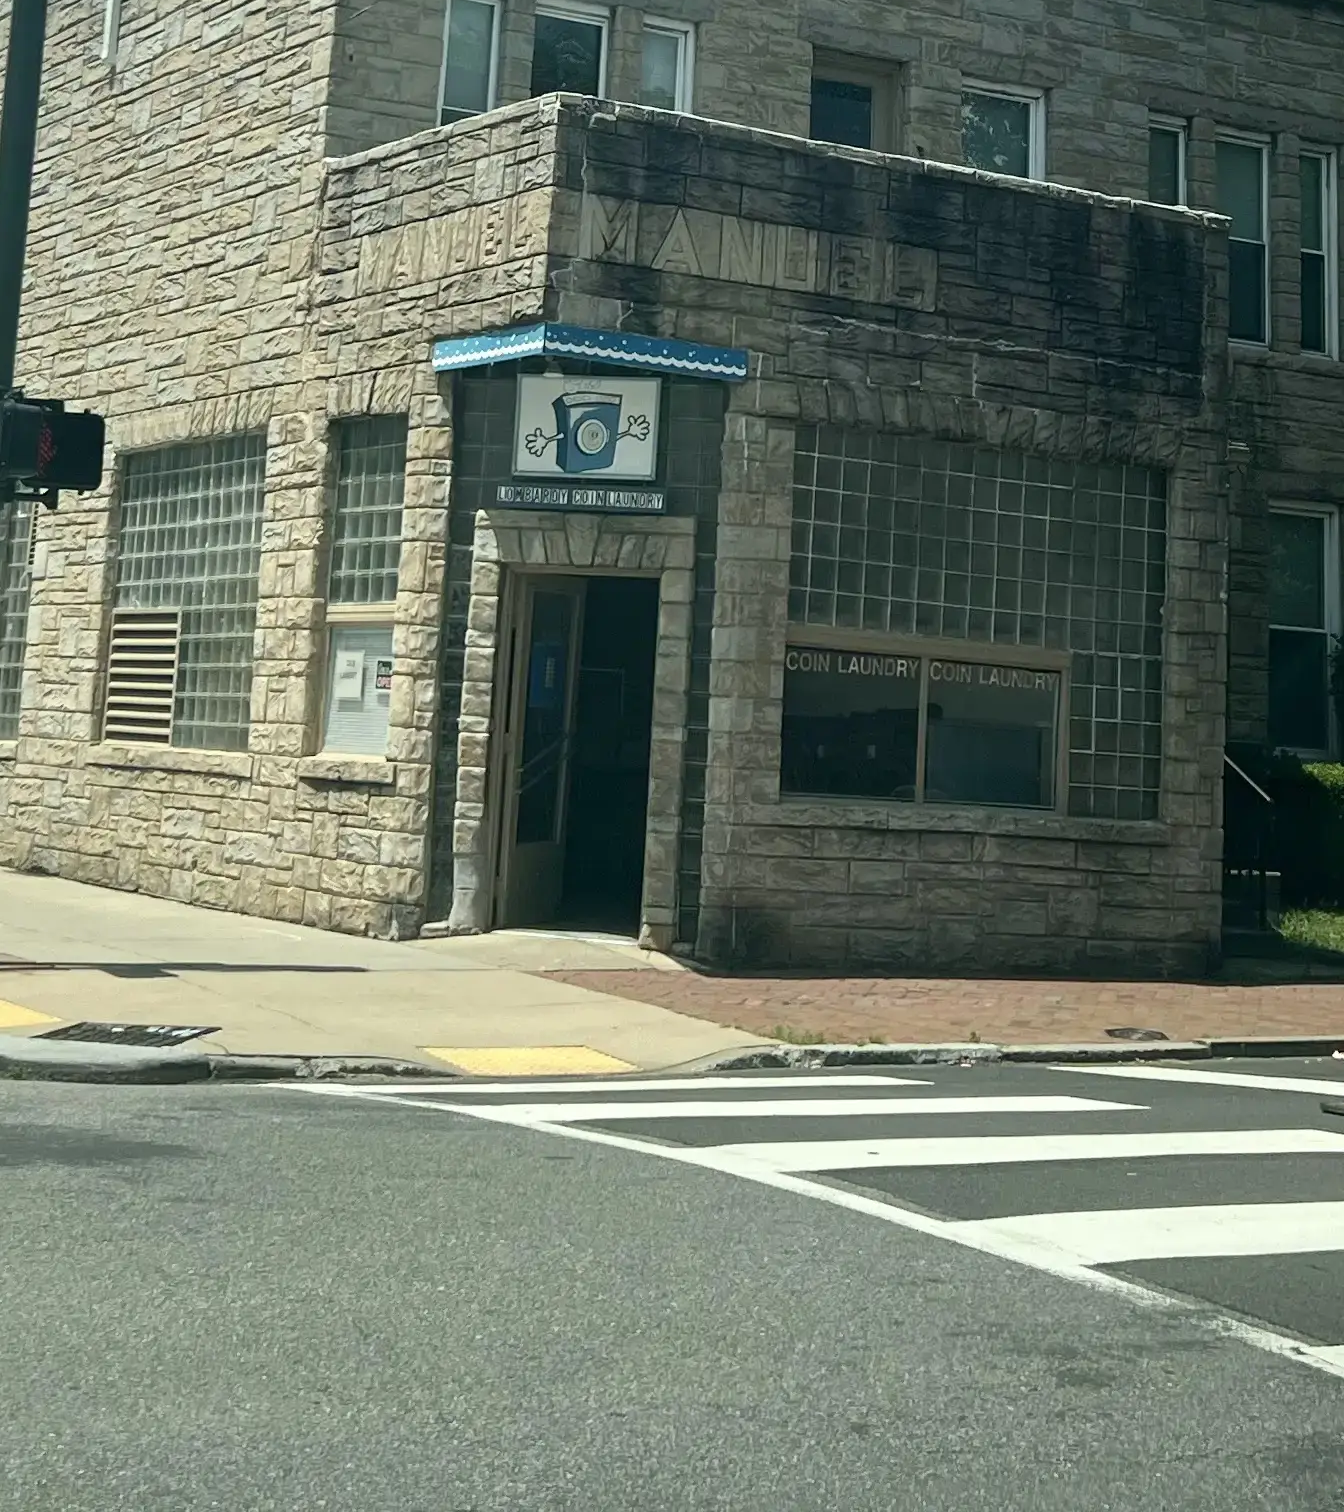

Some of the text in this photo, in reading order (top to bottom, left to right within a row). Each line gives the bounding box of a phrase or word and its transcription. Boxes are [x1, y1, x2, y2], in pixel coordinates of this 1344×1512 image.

[578, 193, 939, 312] MANUEL
[497, 486, 664, 509] LOMBARDY COIN LAUNDRY
[786, 652, 919, 678] COIN LAUNDRY
[930, 662, 1058, 691] COIN LAUNDRY
